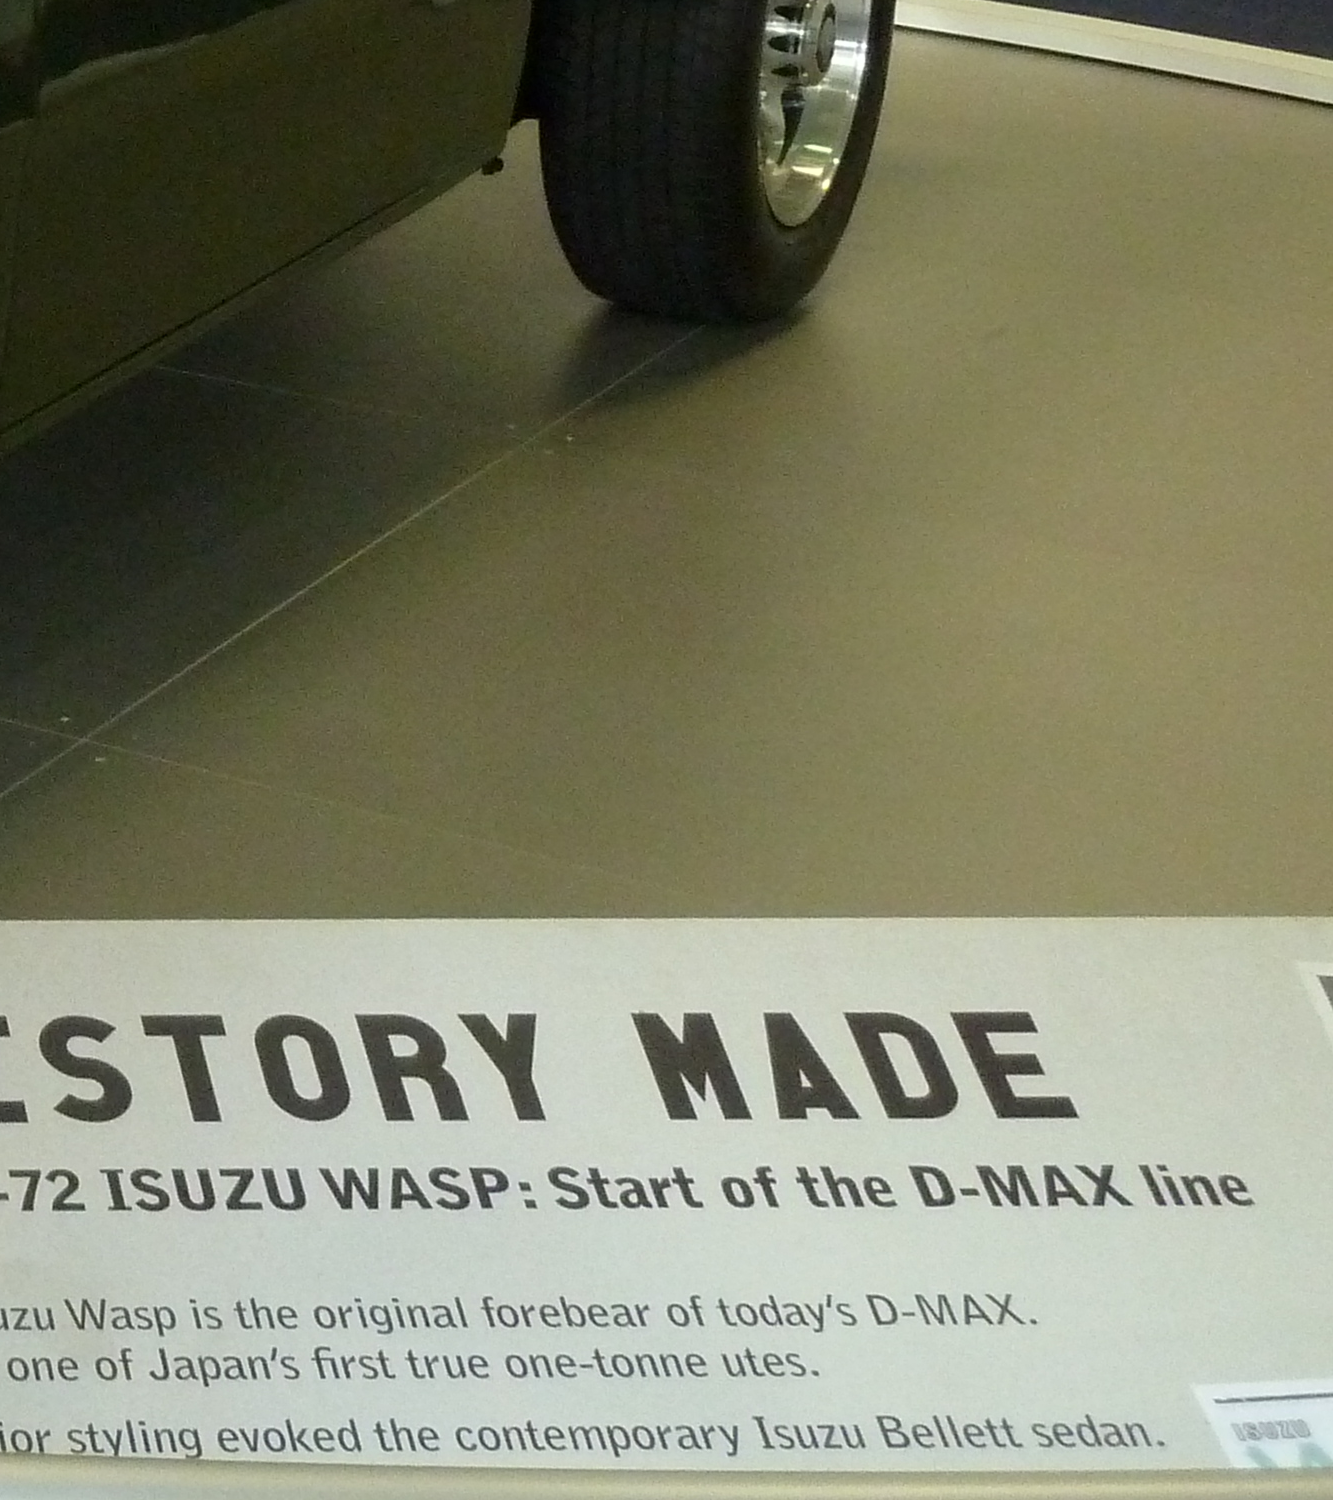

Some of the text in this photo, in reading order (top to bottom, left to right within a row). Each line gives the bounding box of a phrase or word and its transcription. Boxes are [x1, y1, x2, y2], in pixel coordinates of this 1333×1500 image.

[631, 1011, 1080, 1121] MADE
[100, 1167, 307, 1213] ISUZU
[318, 1166, 538, 1211] WASP:
[548, 1166, 705, 1211] Start
[720, 1165, 779, 1209] of
[796, 1165, 899, 1209] the
[909, 1164, 1134, 1208] D-MAX
[1138, 1164, 1256, 1207] line
[64, 1298, 177, 1338] Wasp
[190, 1298, 223, 1330] is
[233, 1297, 299, 1330] the
[313, 1296, 469, 1336] original
[480, 1295, 651, 1329] forebear
[666, 1294, 706, 1328] of
[715, 1293, 858, 1334] today's
[865, 1293, 1038, 1327] D-MAX.
[6, 1356, 79, 1383] one
[94, 1347, 134, 1382] of
[149, 1346, 301, 1388] Japan's
[310, 1345, 397, 1380] first
[404, 1349, 490, 1380] true
[504, 1347, 709, 1380] one-tonne
[720, 1347, 821, 1378] utes.
[66, 1418, 203, 1458] styling
[217, 1418, 362, 1453] evoked
[372, 1417, 441, 1452] the
[455, 1418, 740, 1459] contemporary
[750, 1415, 867, 1451] Isuzu
[875, 1414, 1025, 1450] Bellett
[1031, 1412, 1166, 1449] sedan.
